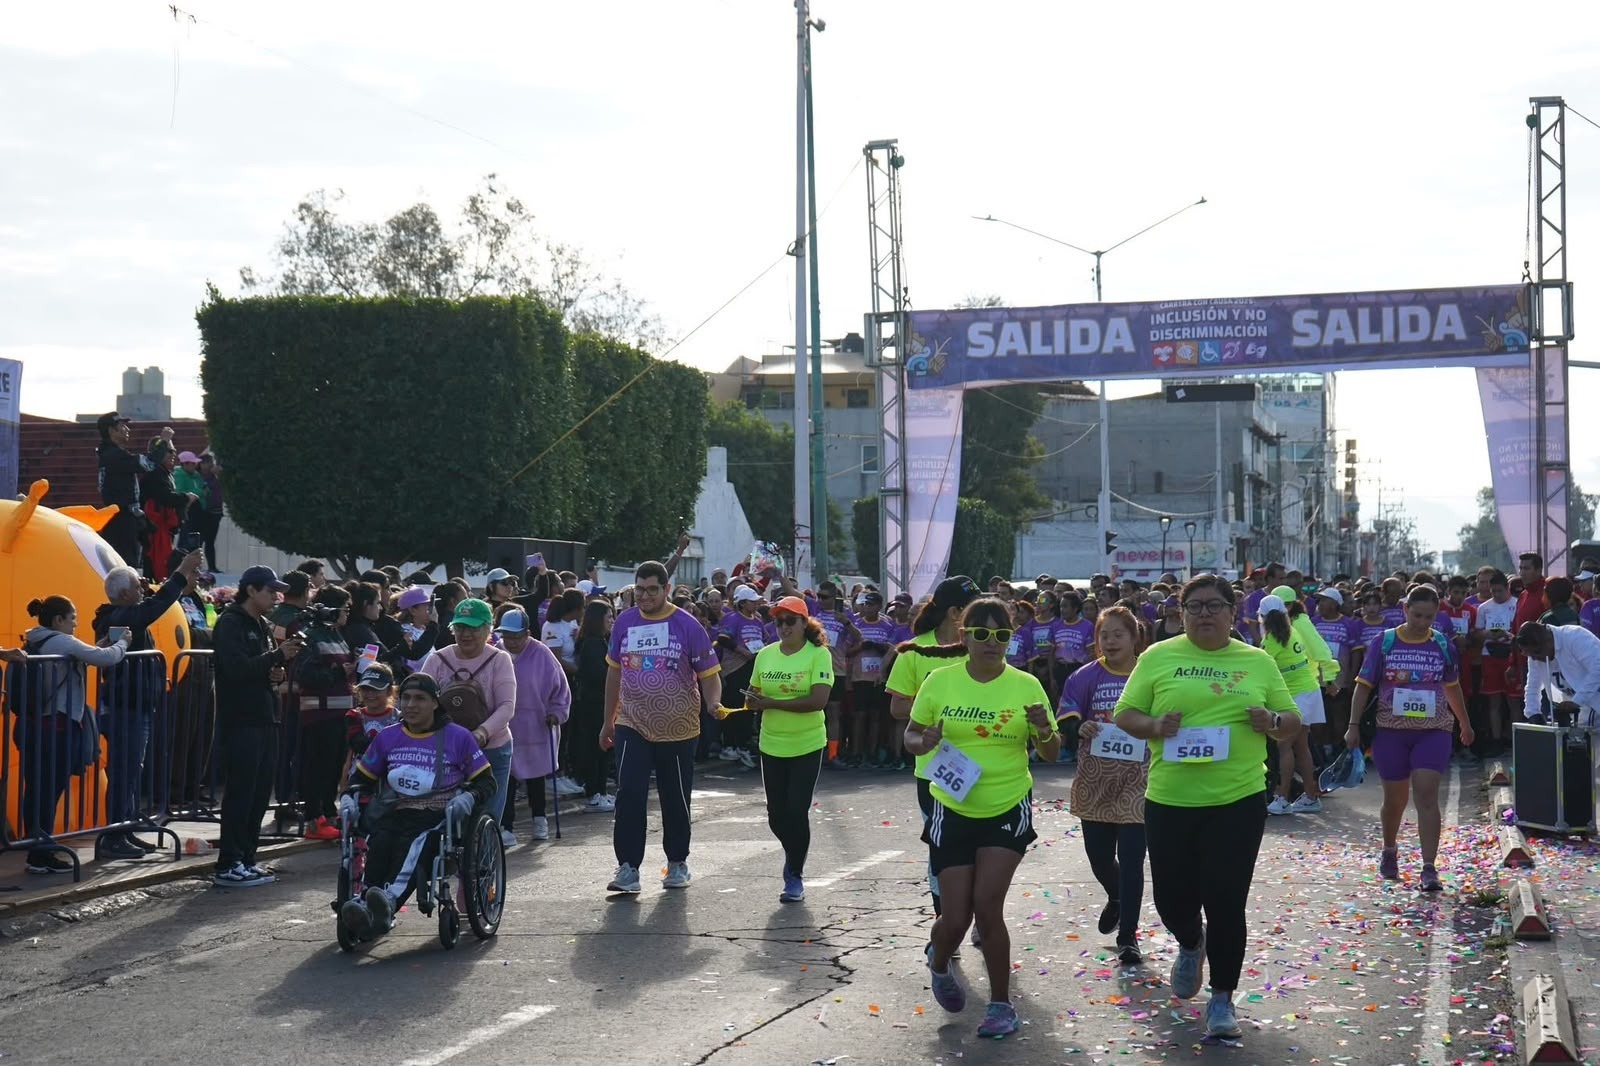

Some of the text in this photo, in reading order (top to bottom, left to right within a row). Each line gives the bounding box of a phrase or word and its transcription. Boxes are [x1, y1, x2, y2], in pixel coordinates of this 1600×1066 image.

[1150, 307, 1266, 325] INCLUSIÓN Y NO
[1150, 323, 1268, 341] DISCRIMINACIÓN
[1292, 304, 1468, 347] SALIDA
[966, 317, 1136, 357] SALIDA
[637, 637, 660, 649] 541
[669, 641, 682, 650] NO
[1173, 666, 1229, 679] Achilles
[941, 705, 997, 720] Achilles
[1403, 702, 1426, 712] 908
[1101, 740, 1134, 756] 540
[1177, 745, 1214, 758] 548
[397, 777, 420, 791] 852
[933, 764, 965, 792] 546
